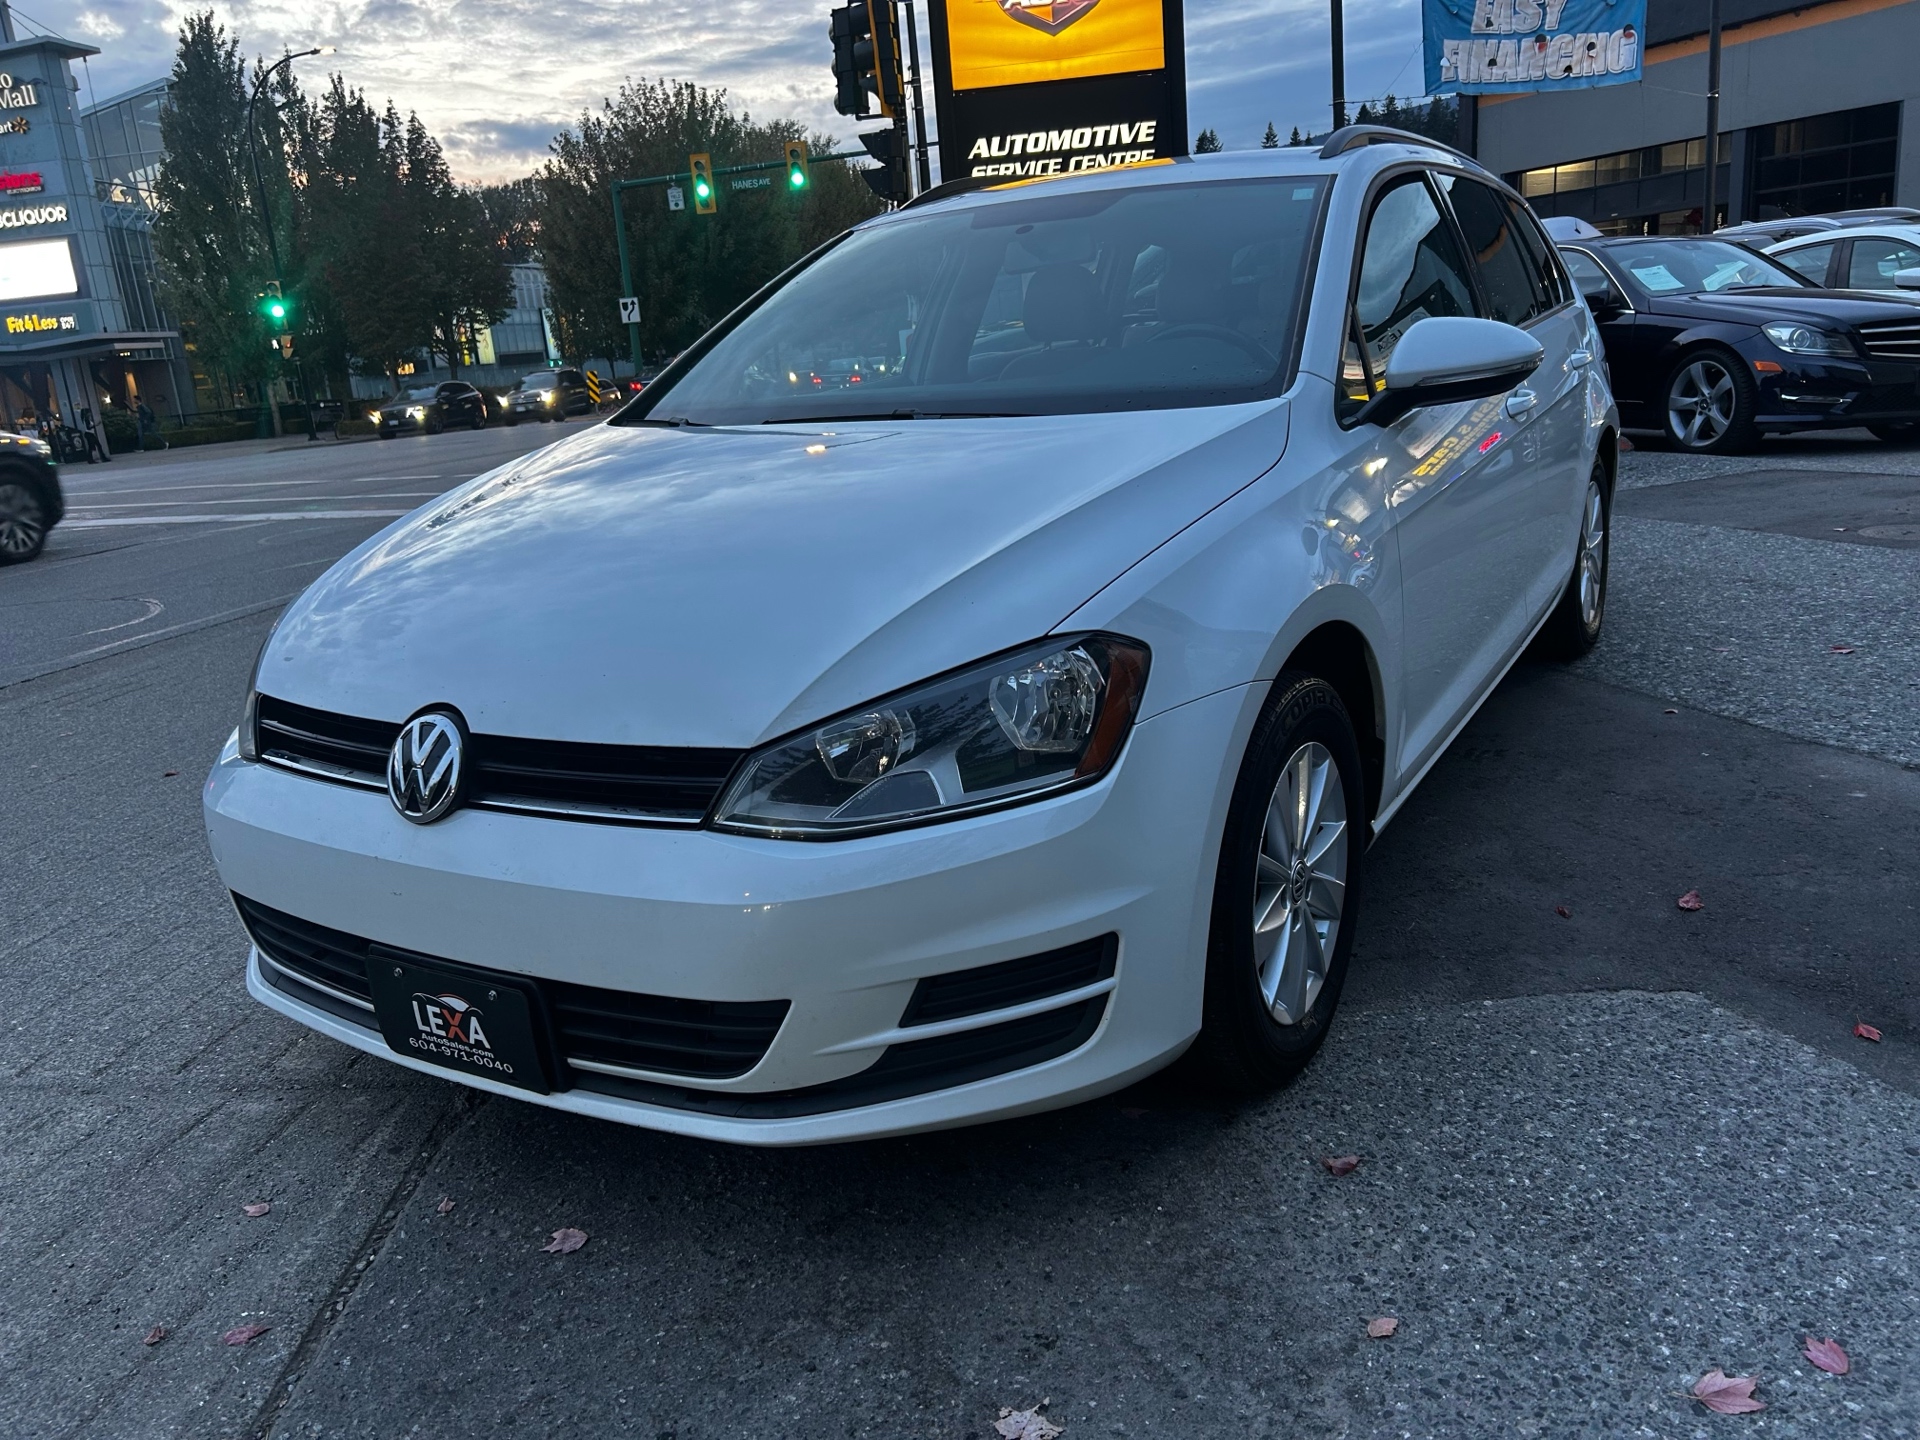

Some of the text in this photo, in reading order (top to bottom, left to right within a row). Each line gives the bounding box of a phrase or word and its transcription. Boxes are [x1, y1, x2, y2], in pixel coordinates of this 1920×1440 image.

[1471, 0, 1568, 34] EASY
[1441, 29, 1638, 83] FINANCING
[0, 85, 37, 109] Mall
[968, 120, 1157, 159] AUTOMOTIVE
[972, 149, 1156, 177] SERVICE CENTRE
[731, 178, 771, 190] HANES AVE
[412, 1000, 491, 1050] LEXA
[409, 1037, 514, 1074] 604-971-0040
[421, 1033, 495, 1059] AutoSales.com
